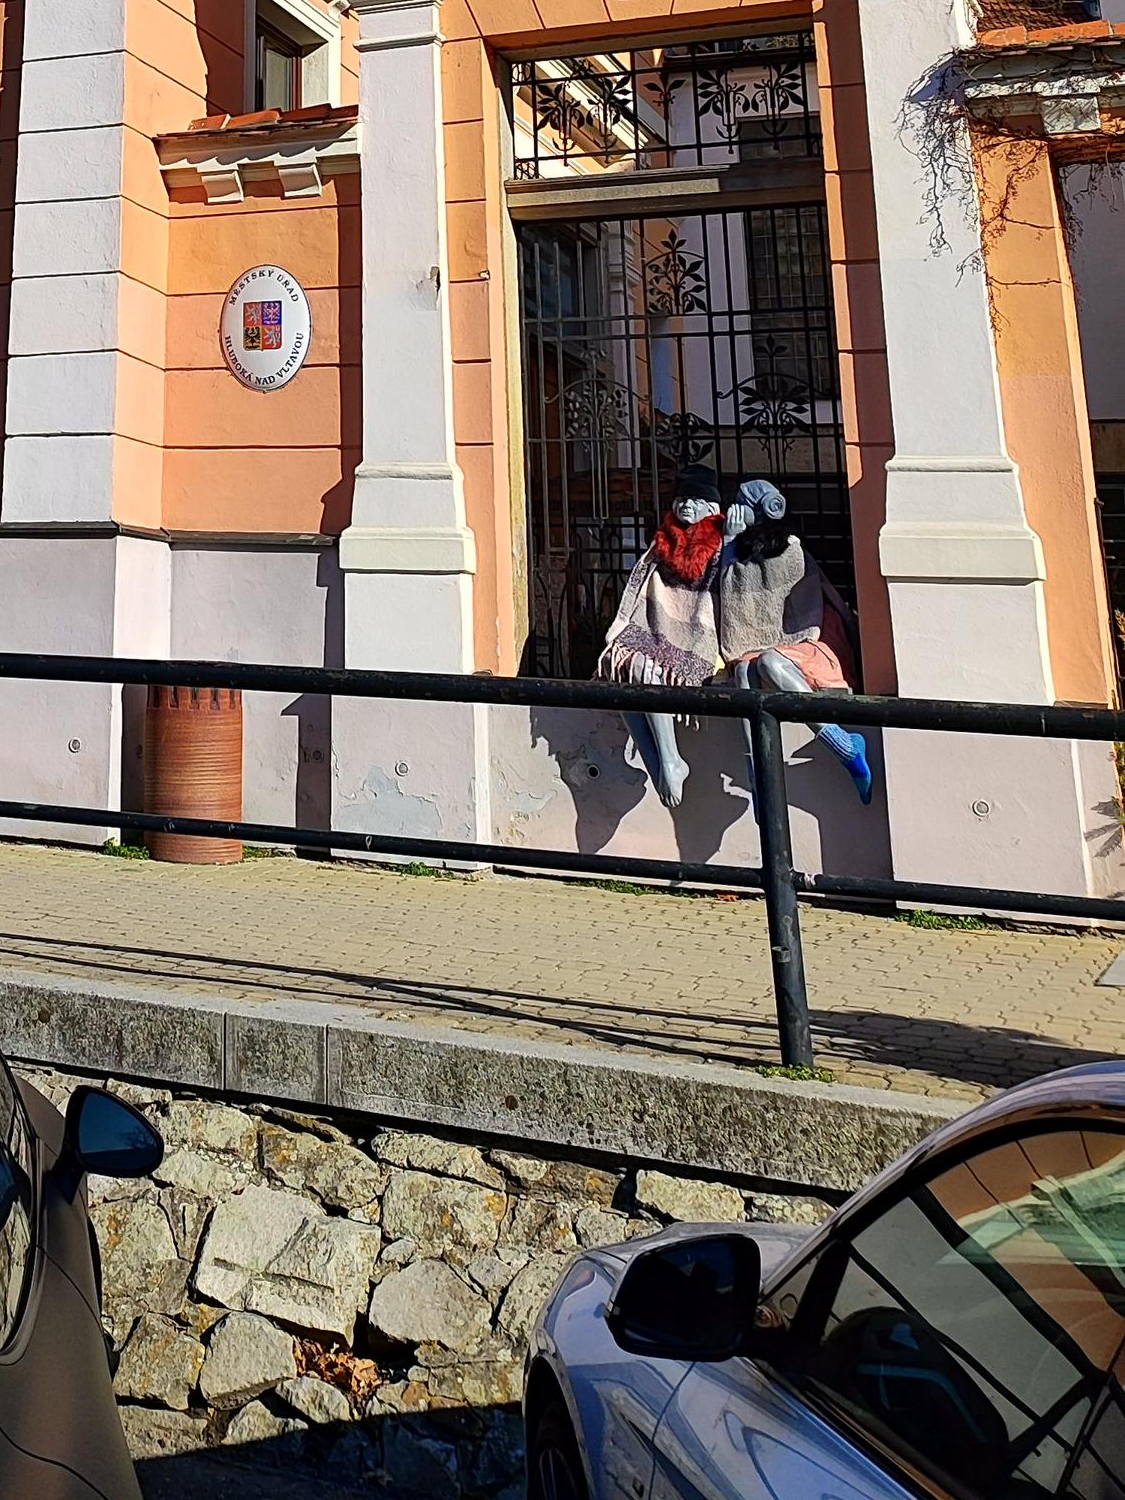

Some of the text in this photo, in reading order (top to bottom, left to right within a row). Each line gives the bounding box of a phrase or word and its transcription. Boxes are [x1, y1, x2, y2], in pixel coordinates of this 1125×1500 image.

[225, 332, 304, 385] HLUBOKÁ NAD VLTAVOU
